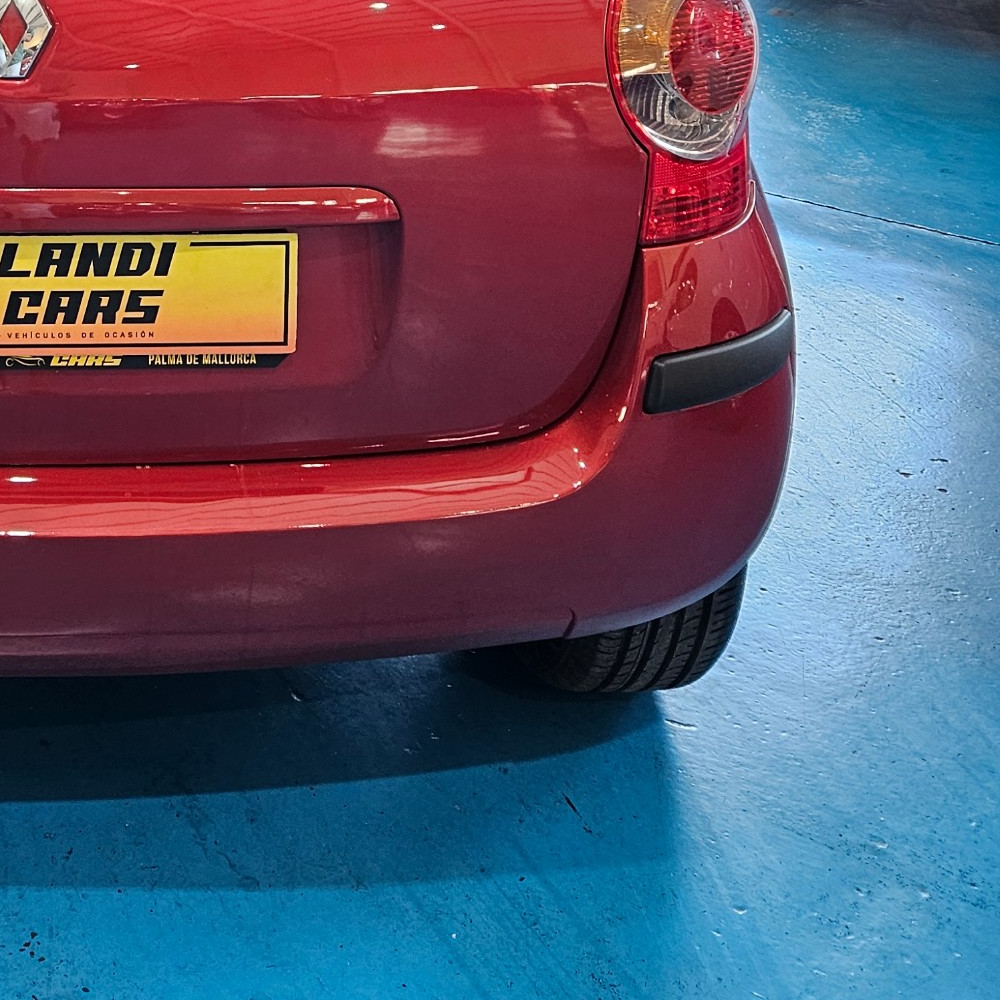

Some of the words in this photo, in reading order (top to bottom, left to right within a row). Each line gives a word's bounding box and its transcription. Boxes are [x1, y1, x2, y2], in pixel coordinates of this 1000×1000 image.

[2, 290, 164, 325] CARS
[7, 331, 72, 339] VEHÍCULOS
[81, 331, 95, 339] DE
[104, 330, 155, 339] OCASIÓN
[50, 355, 121, 366] CARS
[148, 354, 183, 365] PALMA
[186, 354, 199, 364] DE
[202, 353, 257, 364] MALLORCA
